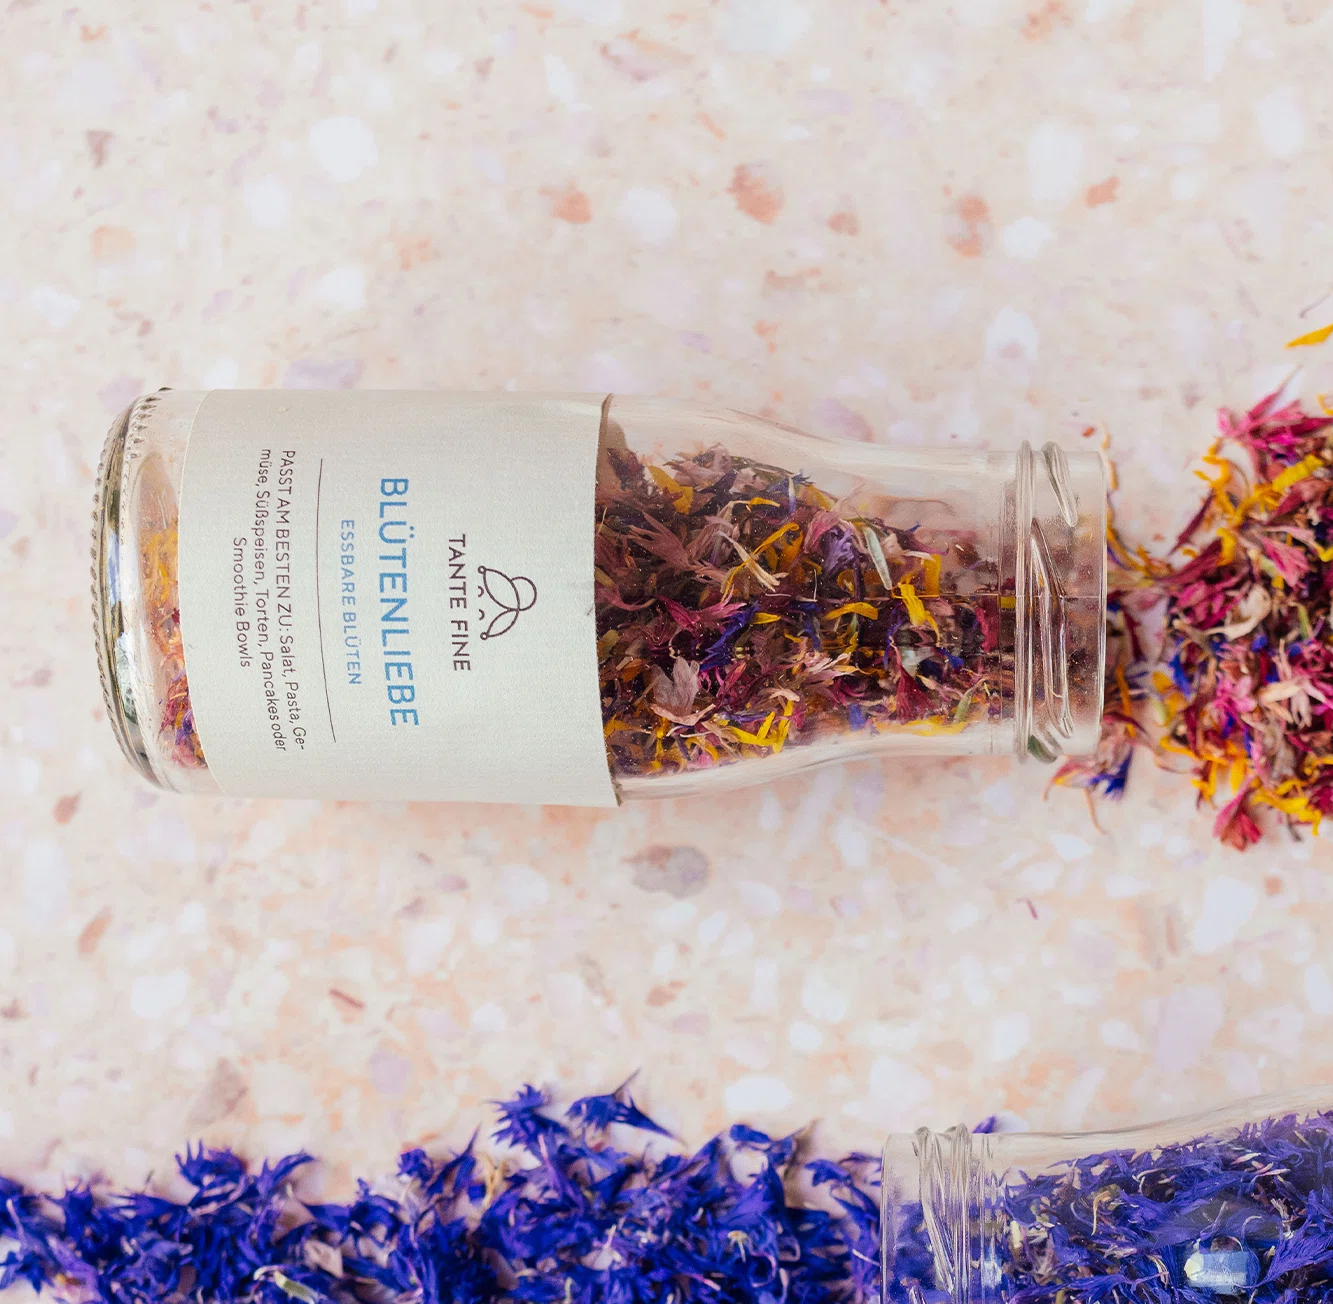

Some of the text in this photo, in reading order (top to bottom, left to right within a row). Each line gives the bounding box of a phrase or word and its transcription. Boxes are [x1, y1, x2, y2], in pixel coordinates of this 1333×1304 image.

[233, 538, 253, 667] Smoothie Bowls
[251, 449, 287, 751] müse, Süßspeisen, Torten, Pancakes oder
[276, 451, 306, 750] PASST AM BESTEN ZU: Salat, Pasta, Ge-
[341, 520, 362, 684] ESSBARE BLÜTEN
[379, 478, 419, 726] BLÜTENLIEBE
[449, 533, 471, 671] TANTE FINE
